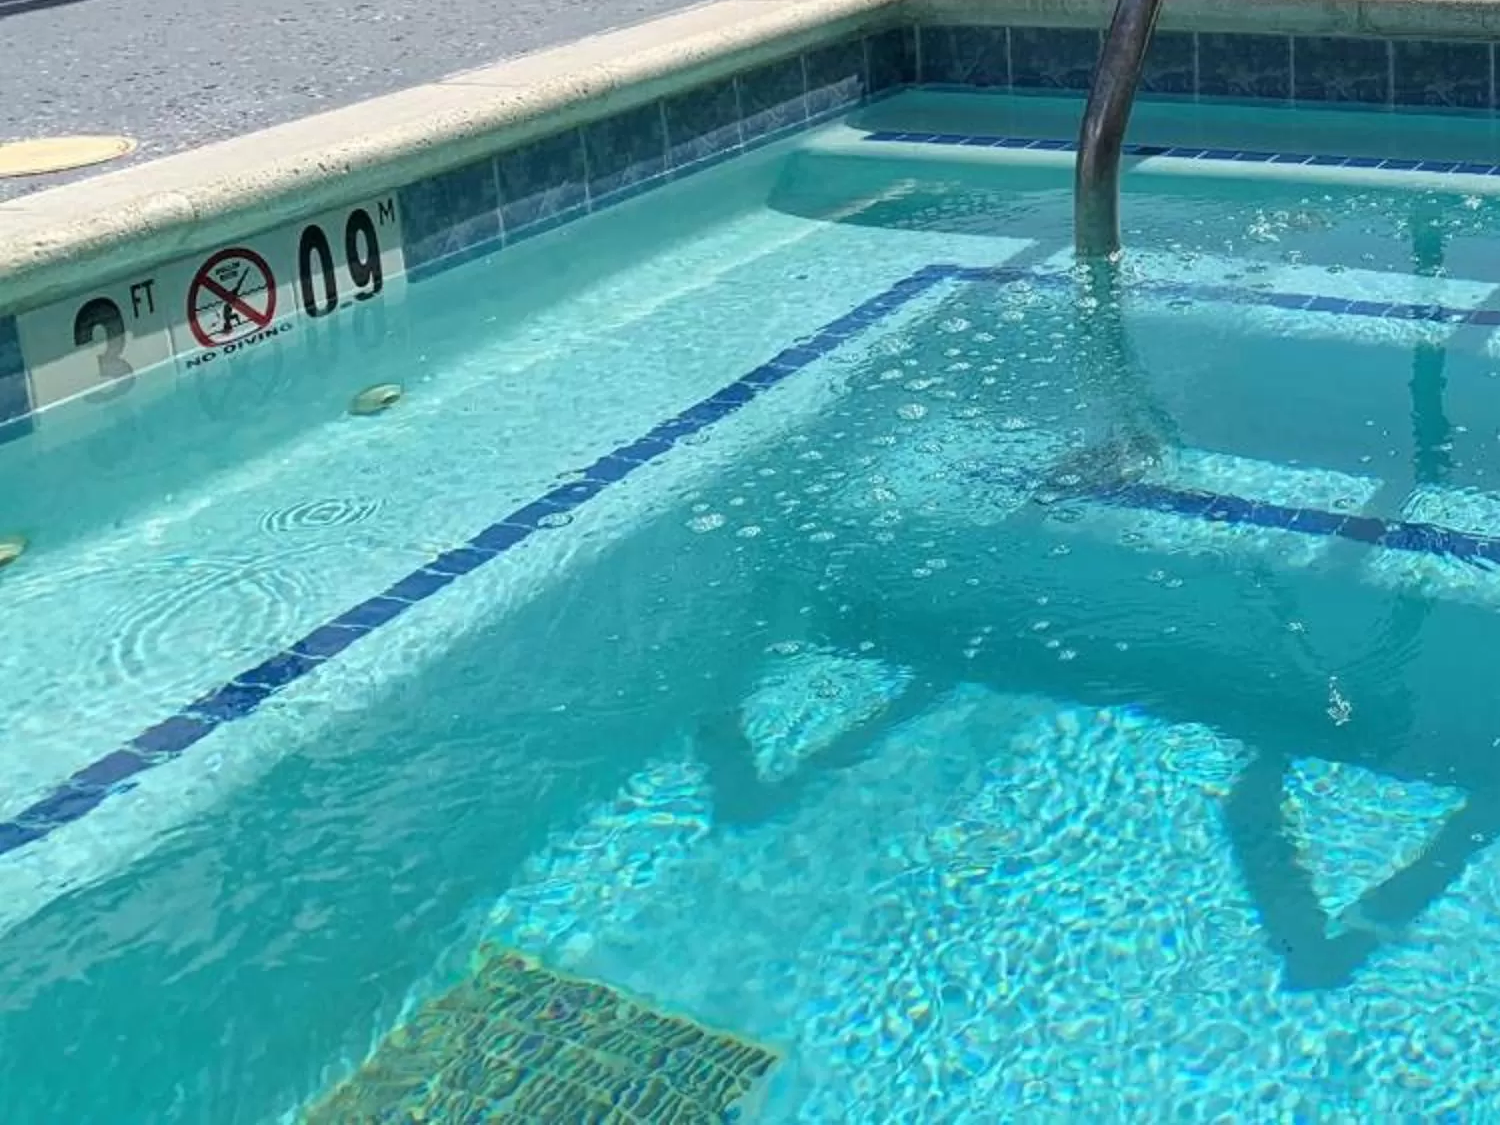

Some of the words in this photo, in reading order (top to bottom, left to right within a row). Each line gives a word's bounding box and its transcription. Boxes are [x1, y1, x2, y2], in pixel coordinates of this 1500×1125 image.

[378, 198, 396, 226] M
[130, 278, 155, 319] FT
[185, 351, 217, 370] NO
[222, 321, 293, 356] DIVING
